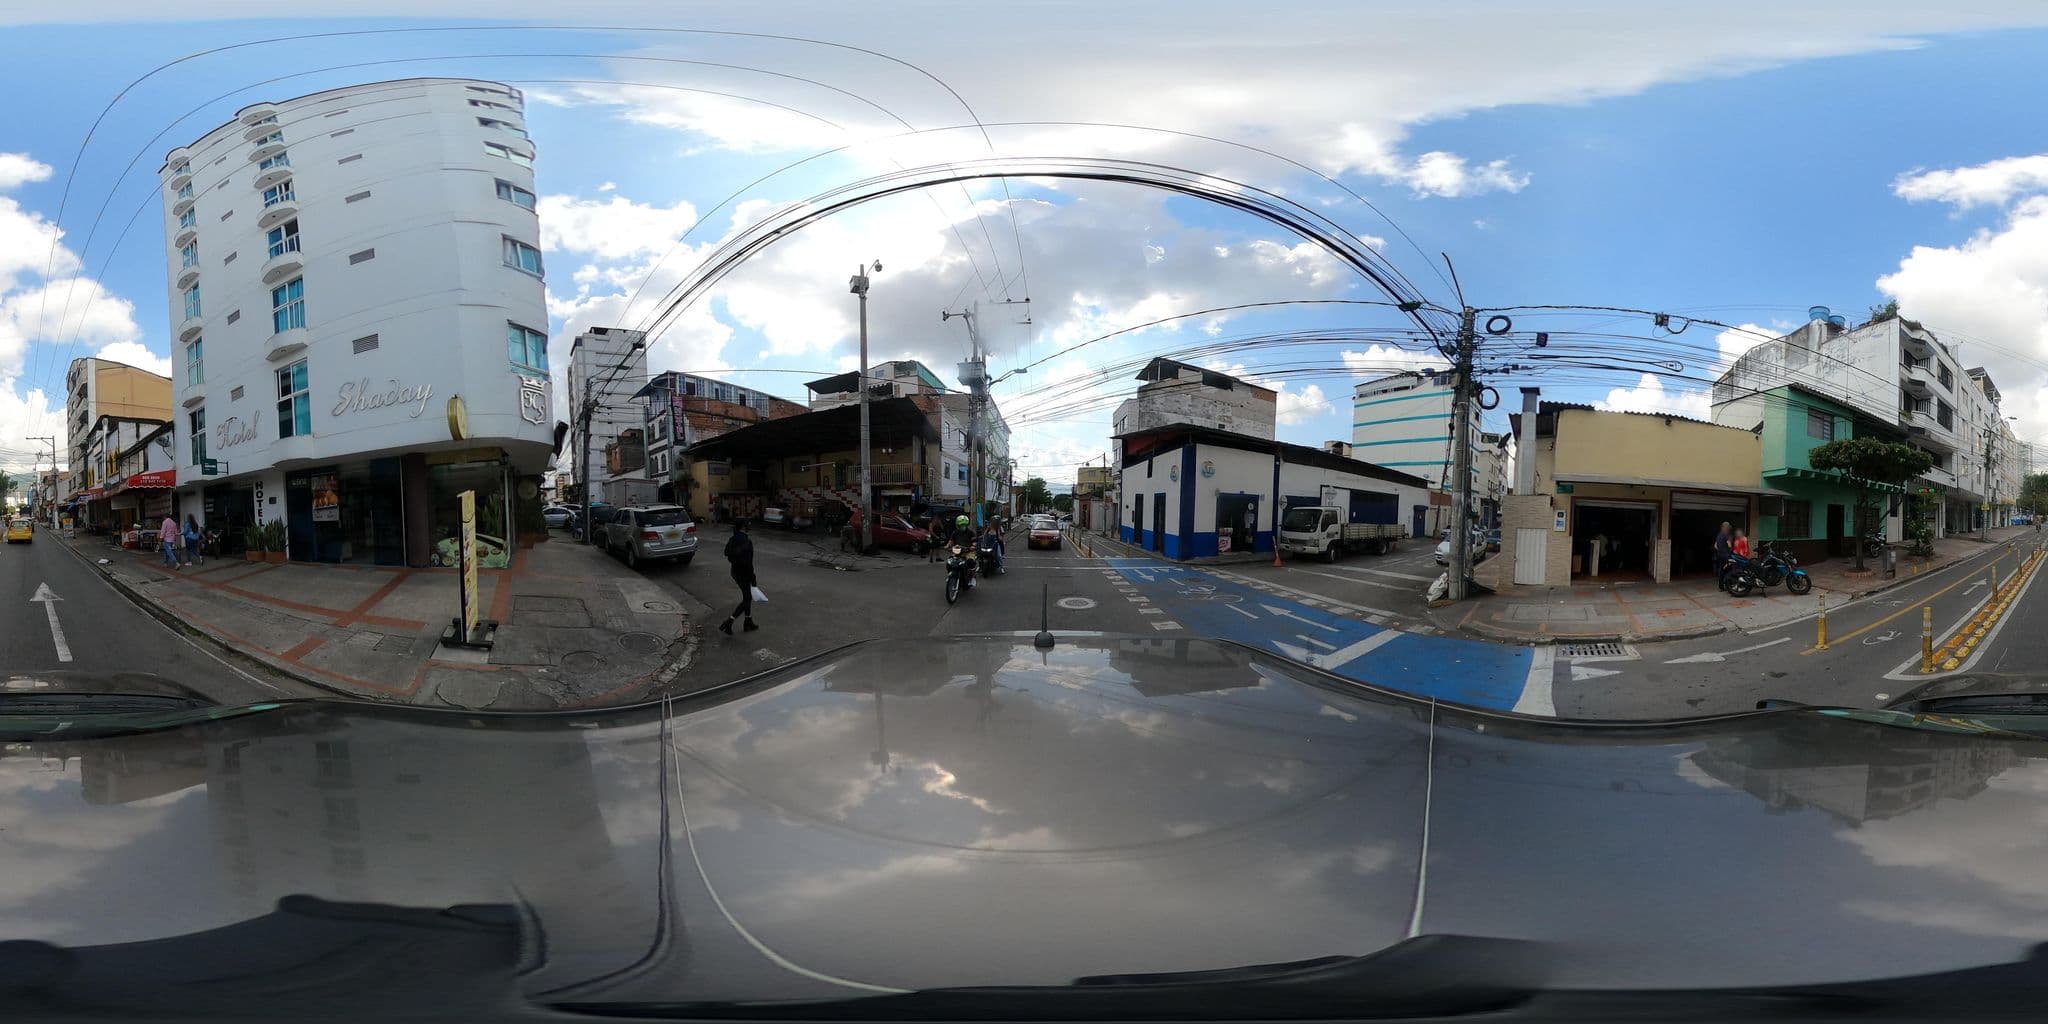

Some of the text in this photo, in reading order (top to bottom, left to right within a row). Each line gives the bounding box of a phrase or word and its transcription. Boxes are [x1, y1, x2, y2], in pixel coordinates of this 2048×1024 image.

[216, 377, 433, 450] Hotel Shaday
[255, 480, 265, 527] HOTEL
